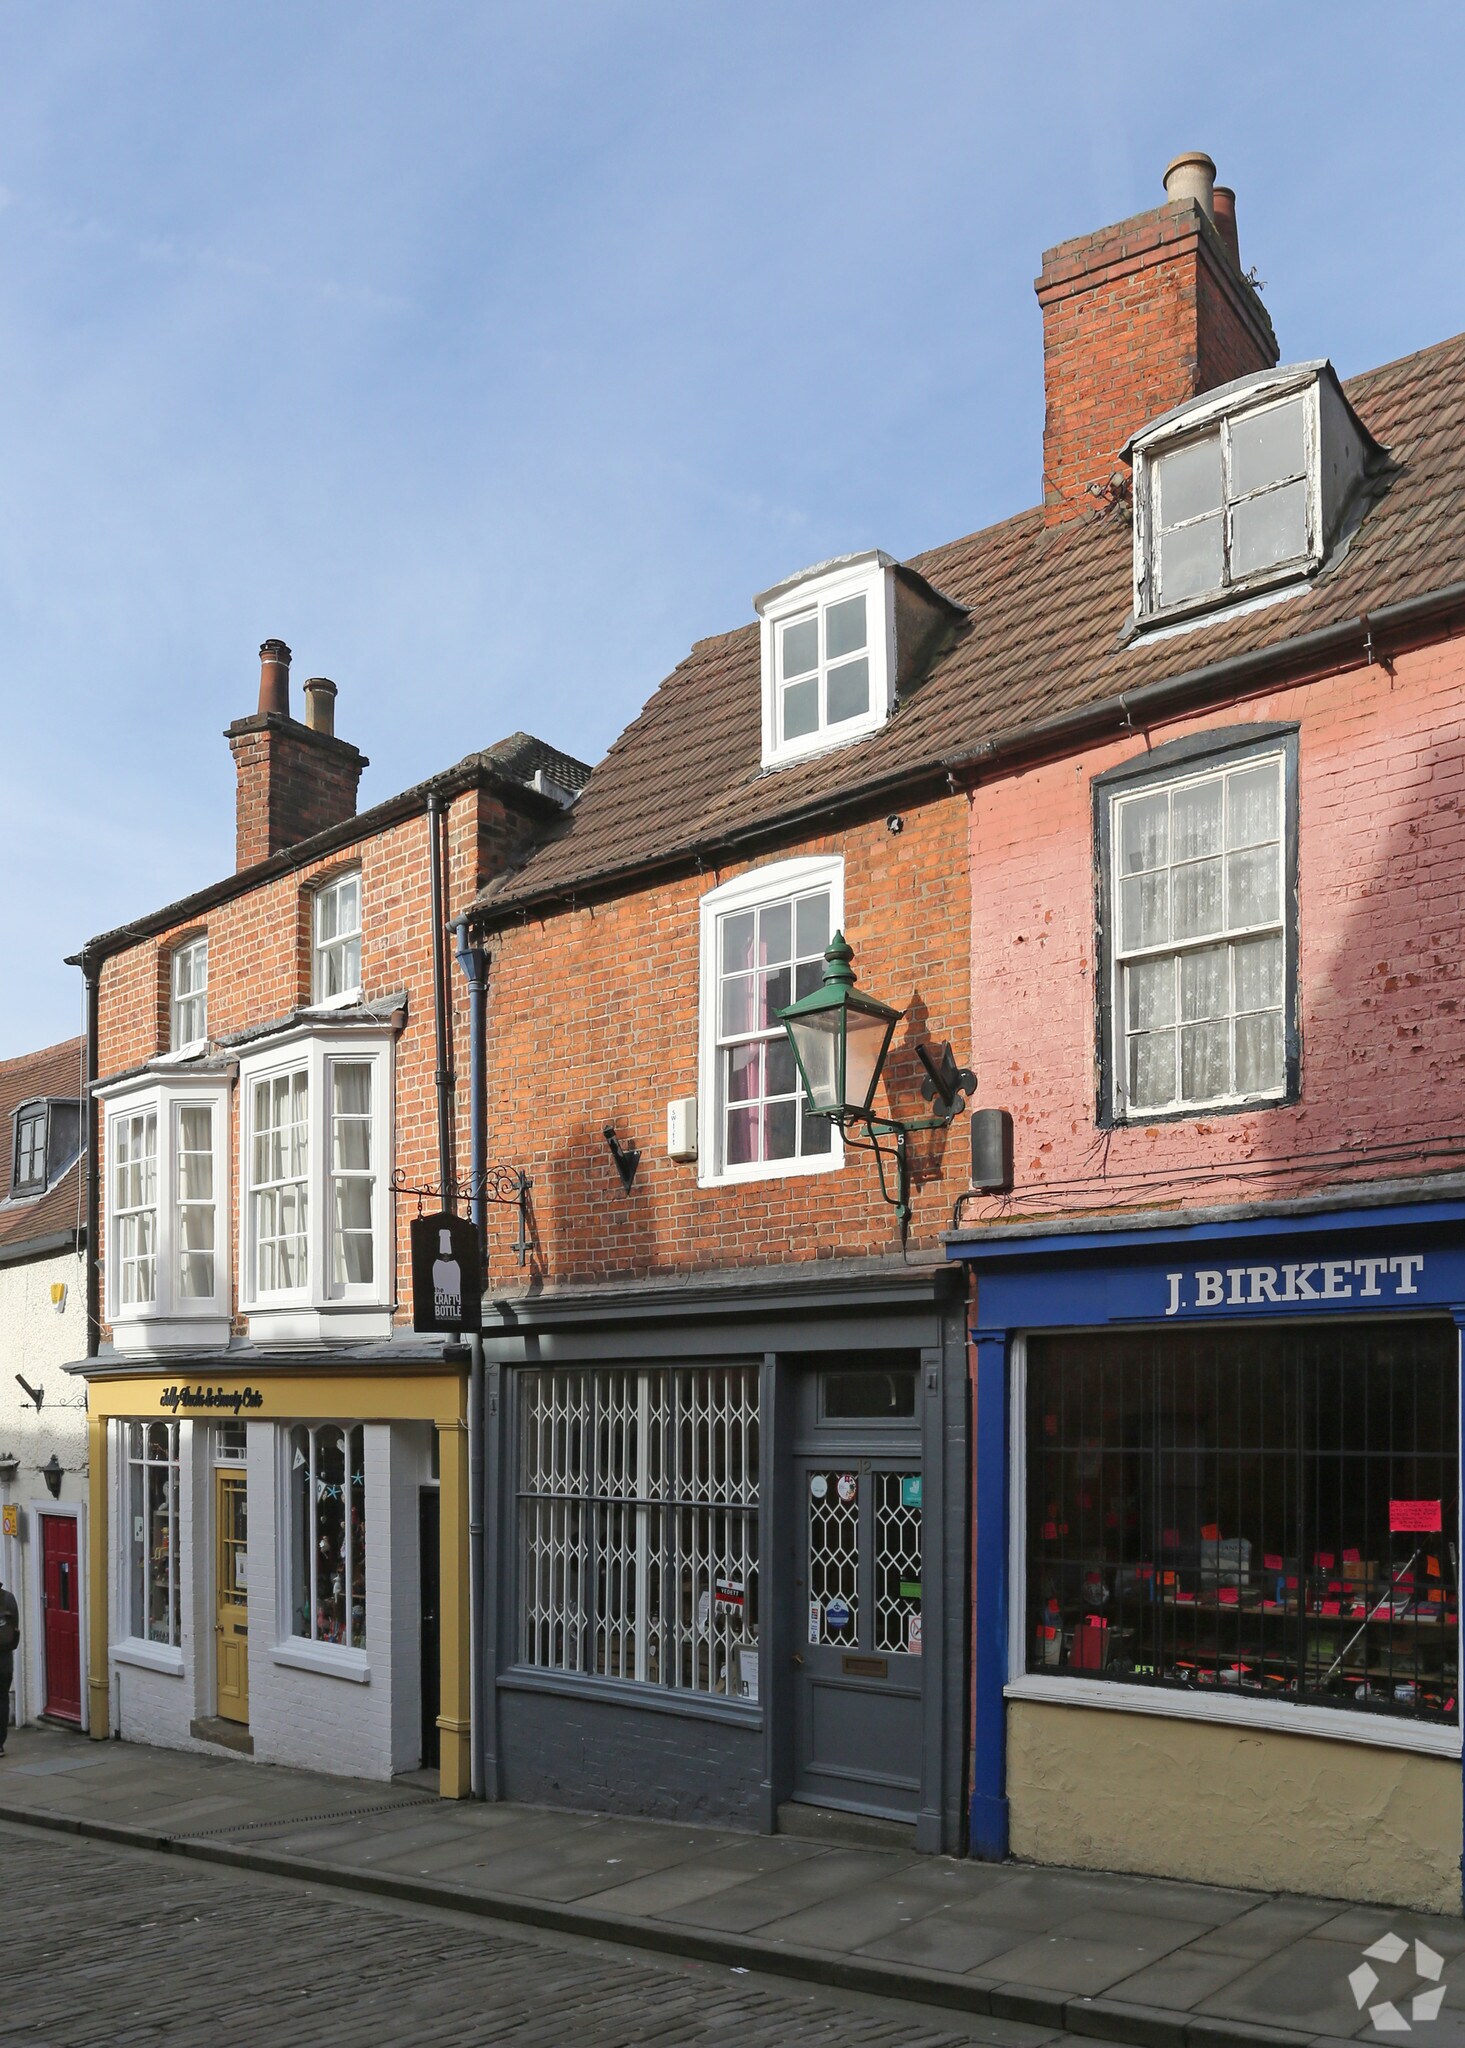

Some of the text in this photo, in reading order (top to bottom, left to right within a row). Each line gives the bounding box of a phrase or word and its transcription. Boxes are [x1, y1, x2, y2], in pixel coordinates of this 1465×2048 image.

[897, 1134, 905, 1145] 5
[1165, 1255, 1424, 1315] J. BIRKETT
[434, 1294, 461, 1305] CRAFTY
[434, 1306, 461, 1317] BOTTLE
[857, 1457, 872, 1476] 12
